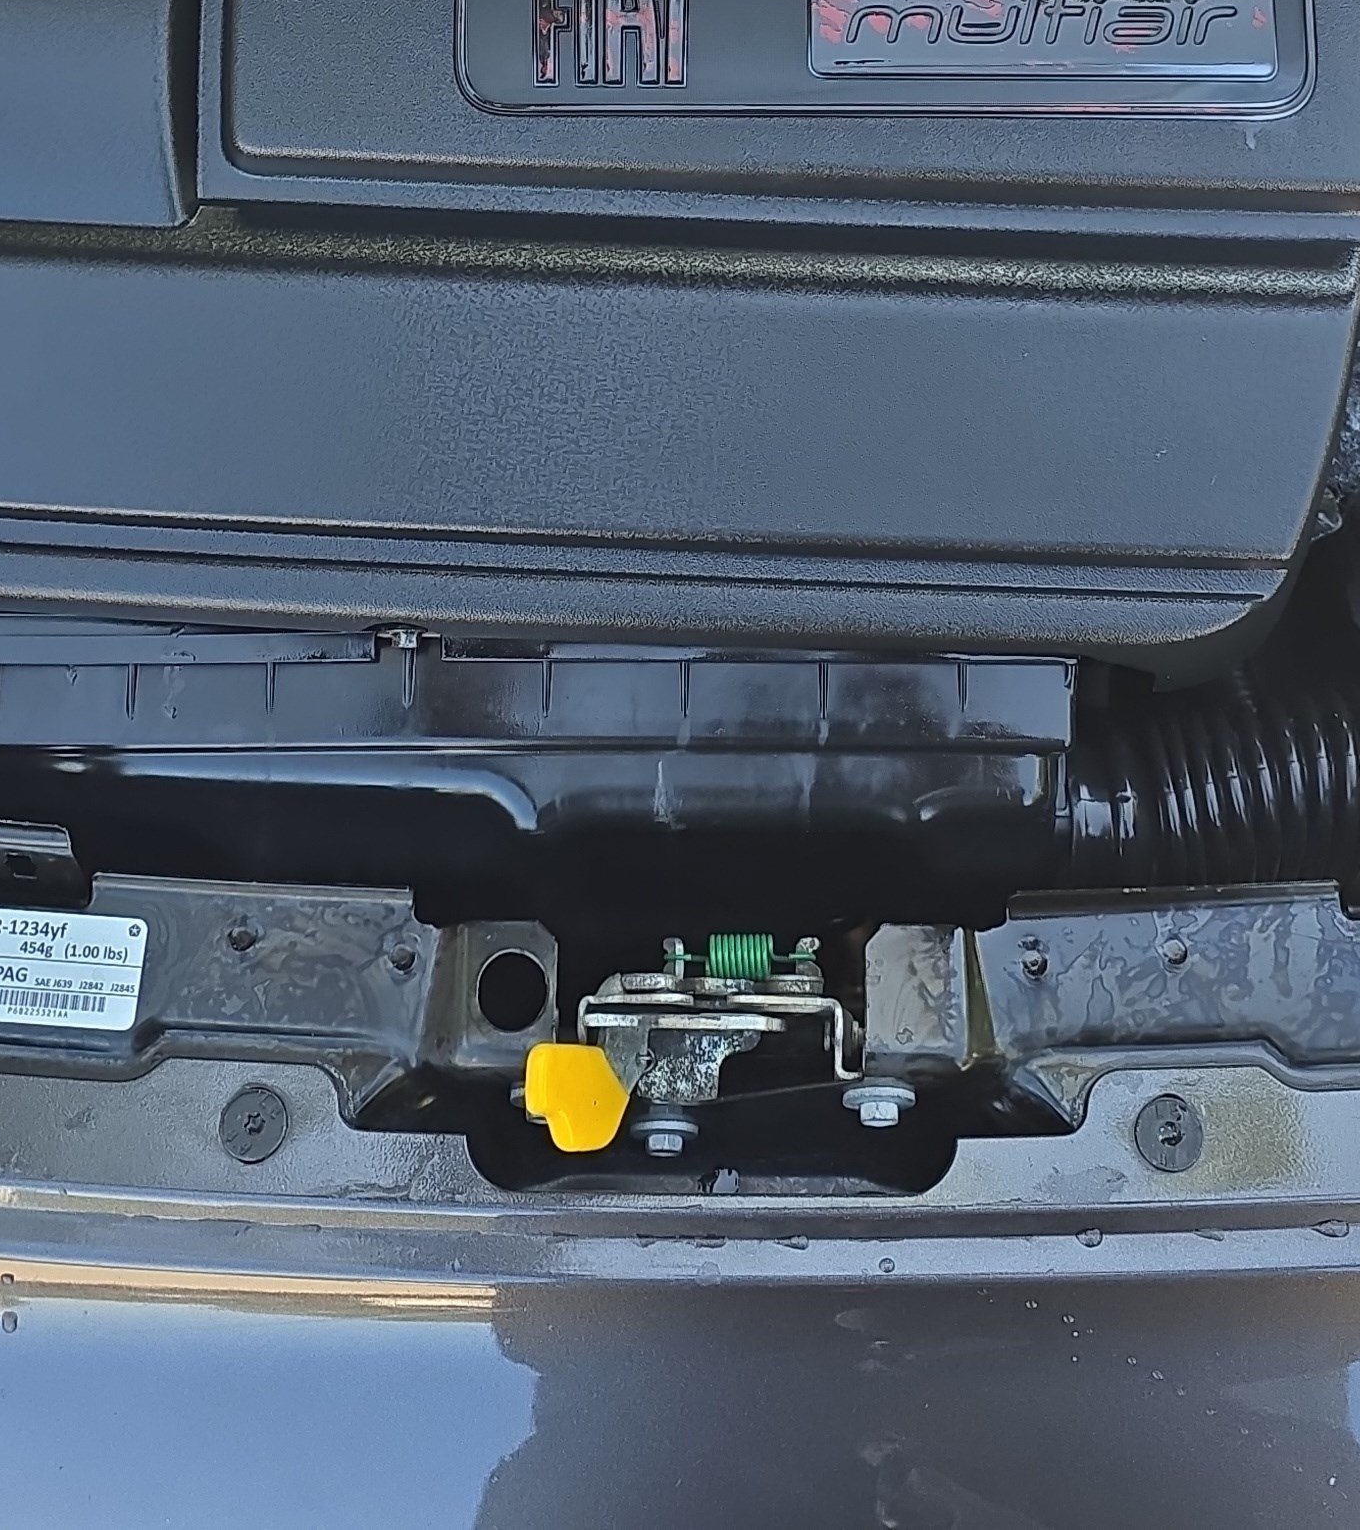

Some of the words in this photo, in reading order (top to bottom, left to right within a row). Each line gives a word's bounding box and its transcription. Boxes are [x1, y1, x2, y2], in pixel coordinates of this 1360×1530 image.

[19, 941, 53, 958] 454g
[64, 943, 100, 961] (1.00
[102, 944, 129, 963] lbs)
[34, 978, 50, 986] SAE
[52, 980, 73, 989] J639
[79, 981, 104, 991] J2842
[110, 984, 135, 993] J2845
